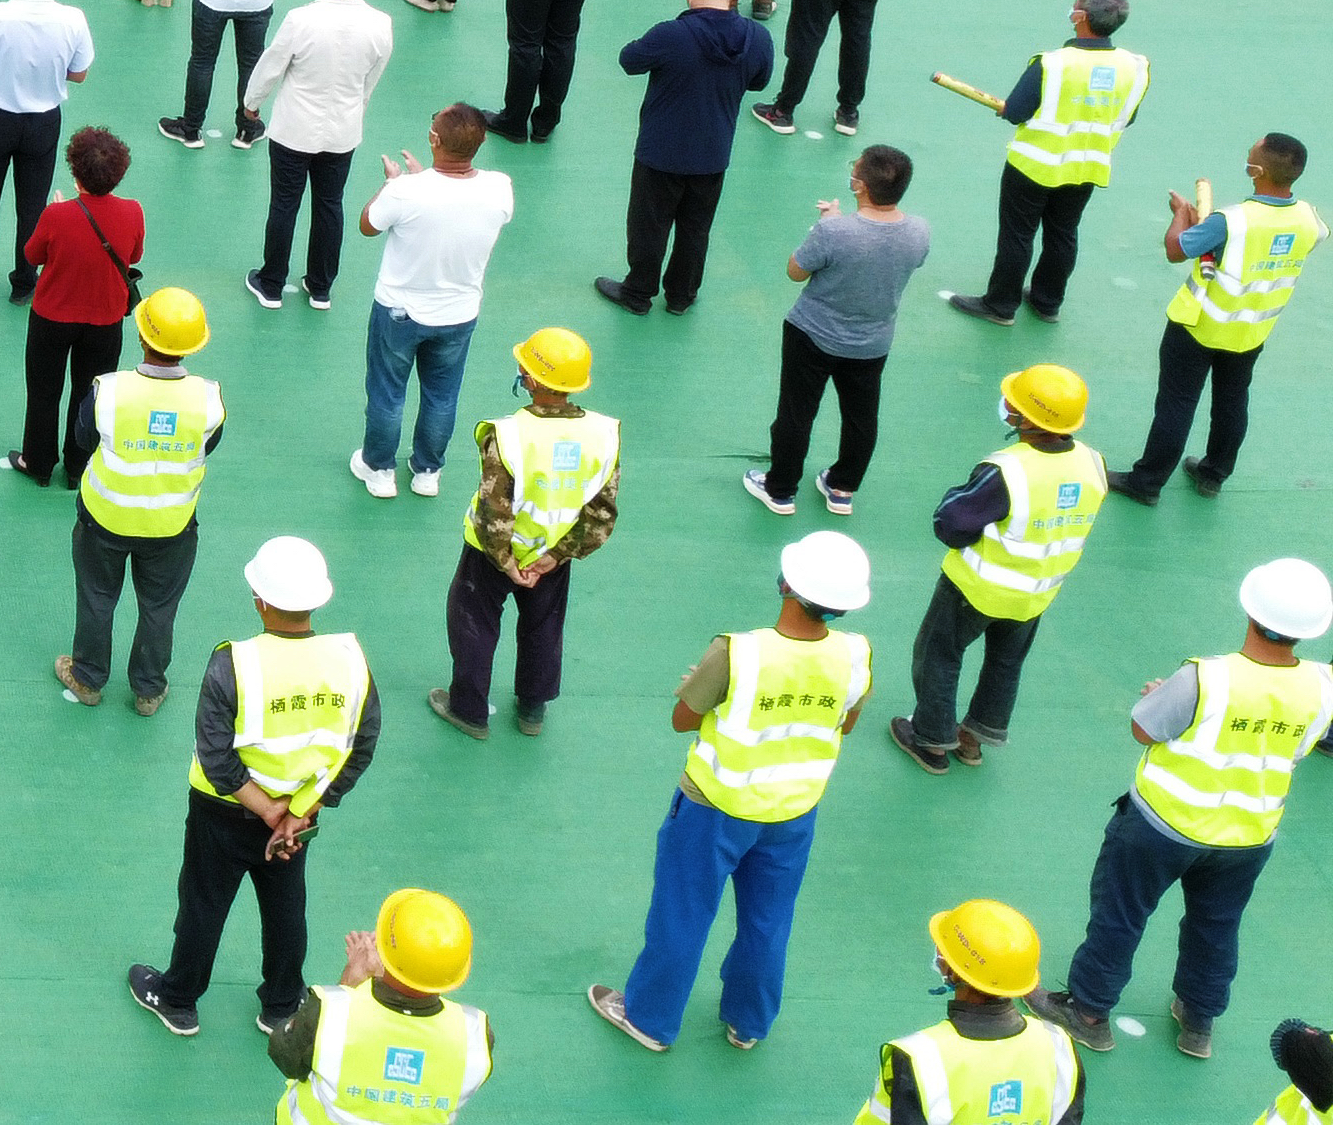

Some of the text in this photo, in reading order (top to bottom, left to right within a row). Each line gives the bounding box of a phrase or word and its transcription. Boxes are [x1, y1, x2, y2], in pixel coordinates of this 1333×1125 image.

[270, 692, 346, 714] 栖霞市政
[758, 693, 837, 712] 栖霞市政
[346, 1085, 451, 1112] 中国建筑五局
